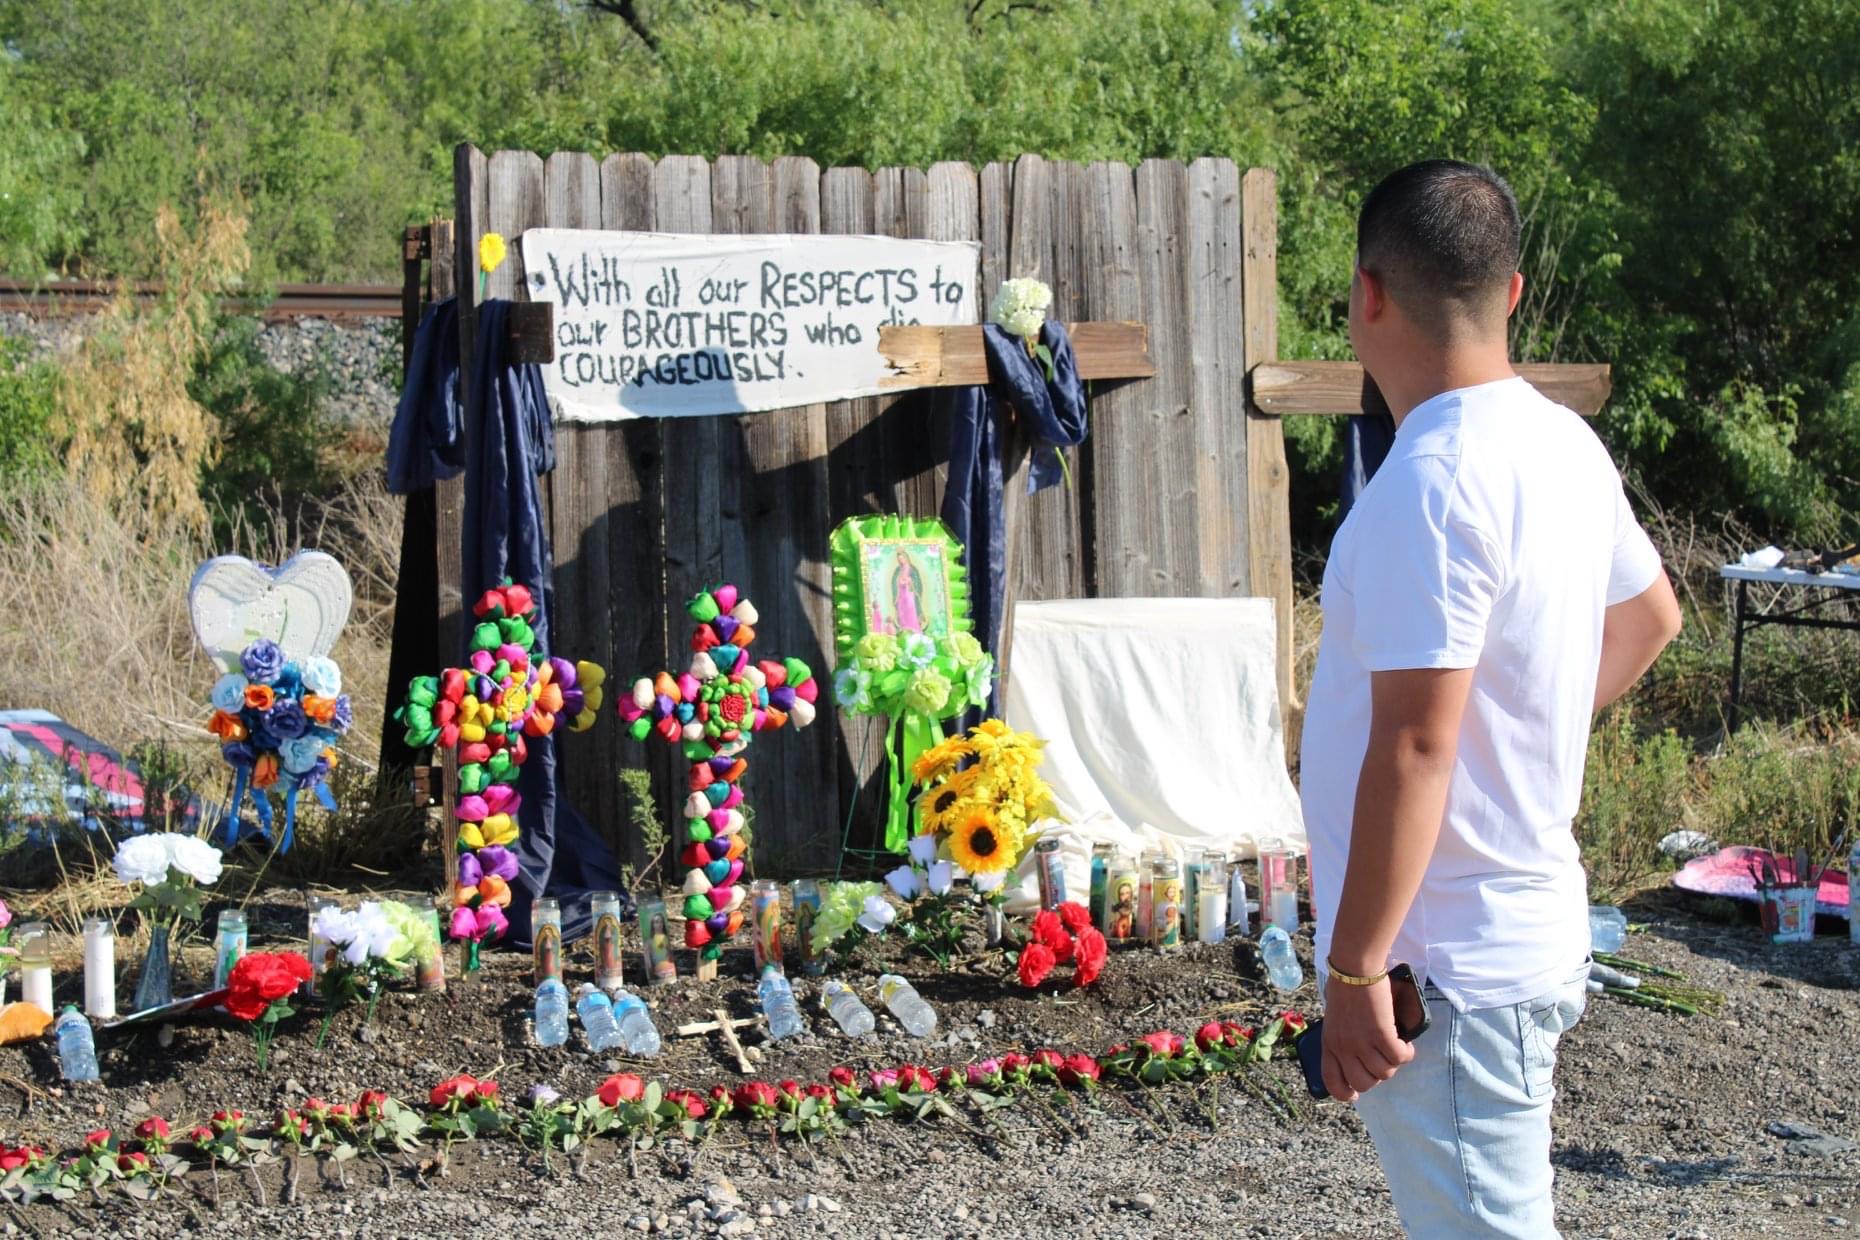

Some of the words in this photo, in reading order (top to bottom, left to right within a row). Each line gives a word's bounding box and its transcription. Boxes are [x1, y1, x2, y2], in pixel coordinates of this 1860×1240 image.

[547, 252, 630, 308] With
[646, 267, 680, 307] all
[699, 278, 748, 304] our
[761, 261, 919, 309] RESPECTS
[929, 265, 963, 304] to
[558, 320, 607, 347] our
[622, 309, 788, 349] BROTHERS
[804, 311, 862, 347] who
